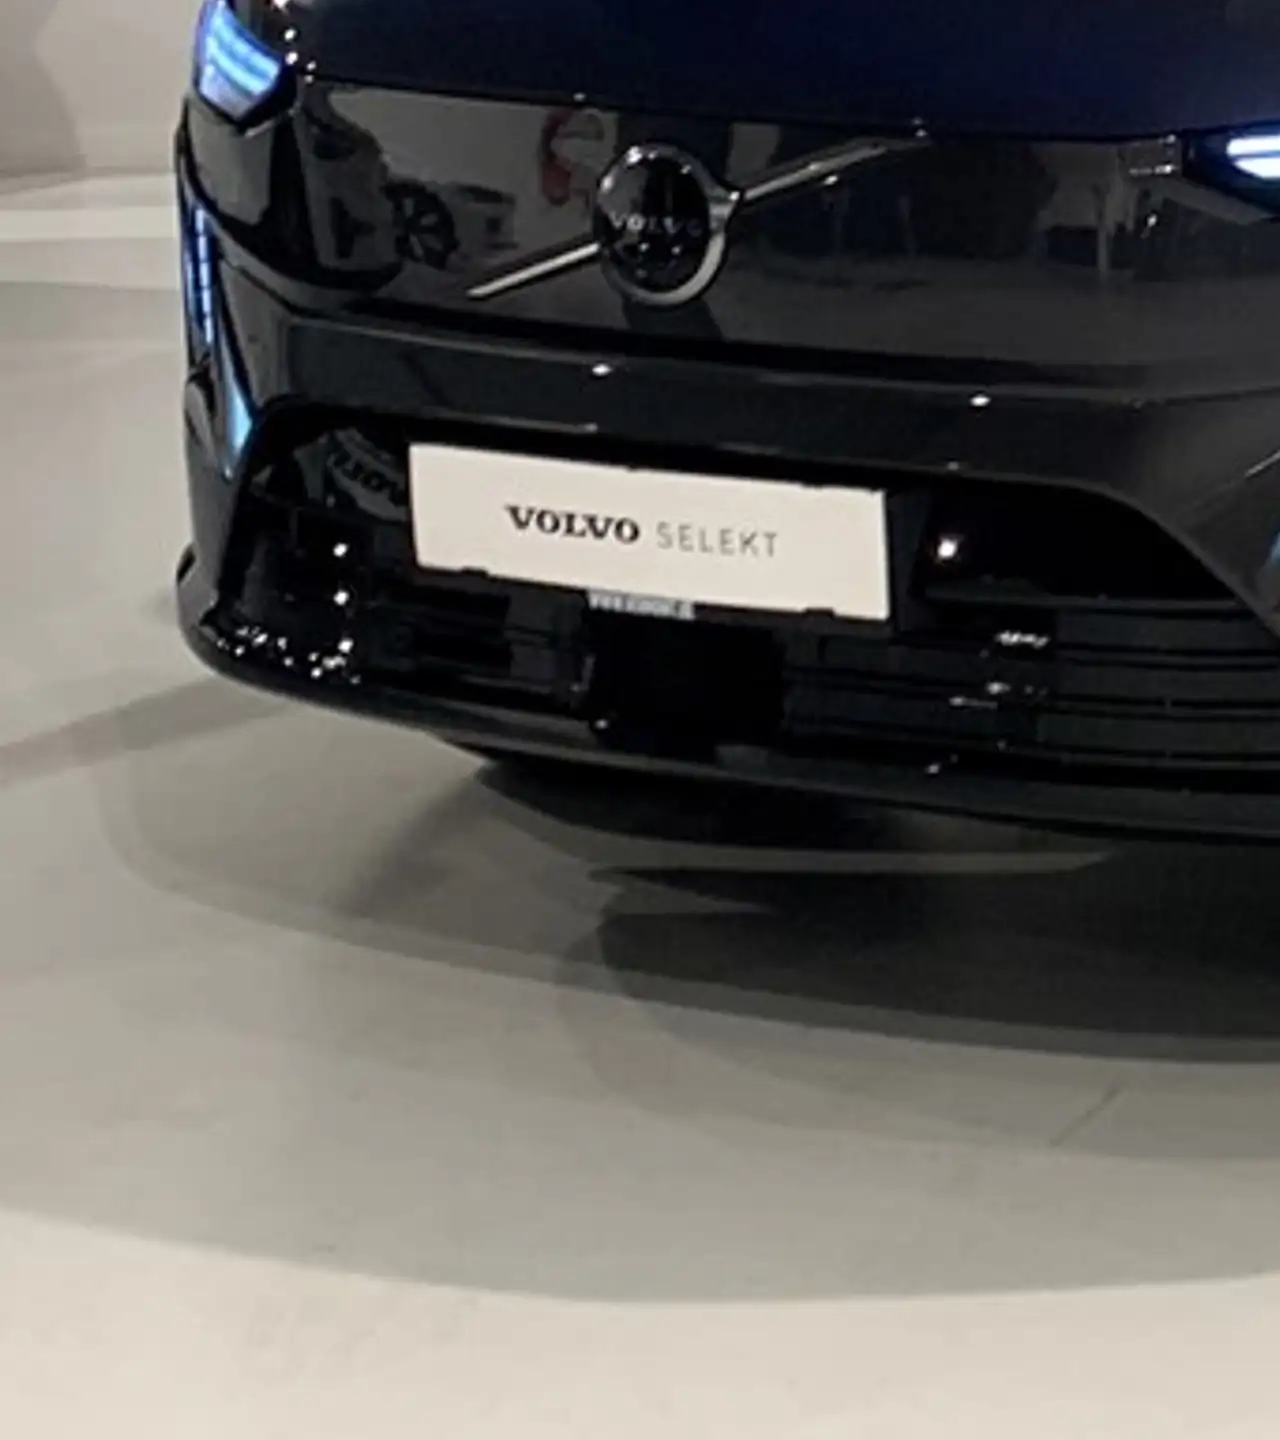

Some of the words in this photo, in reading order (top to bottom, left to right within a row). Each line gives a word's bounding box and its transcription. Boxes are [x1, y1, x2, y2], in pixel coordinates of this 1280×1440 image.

[608, 211, 703, 237] VOLVO
[506, 504, 640, 544] VOLVO
[655, 521, 778, 558] SELEKT
